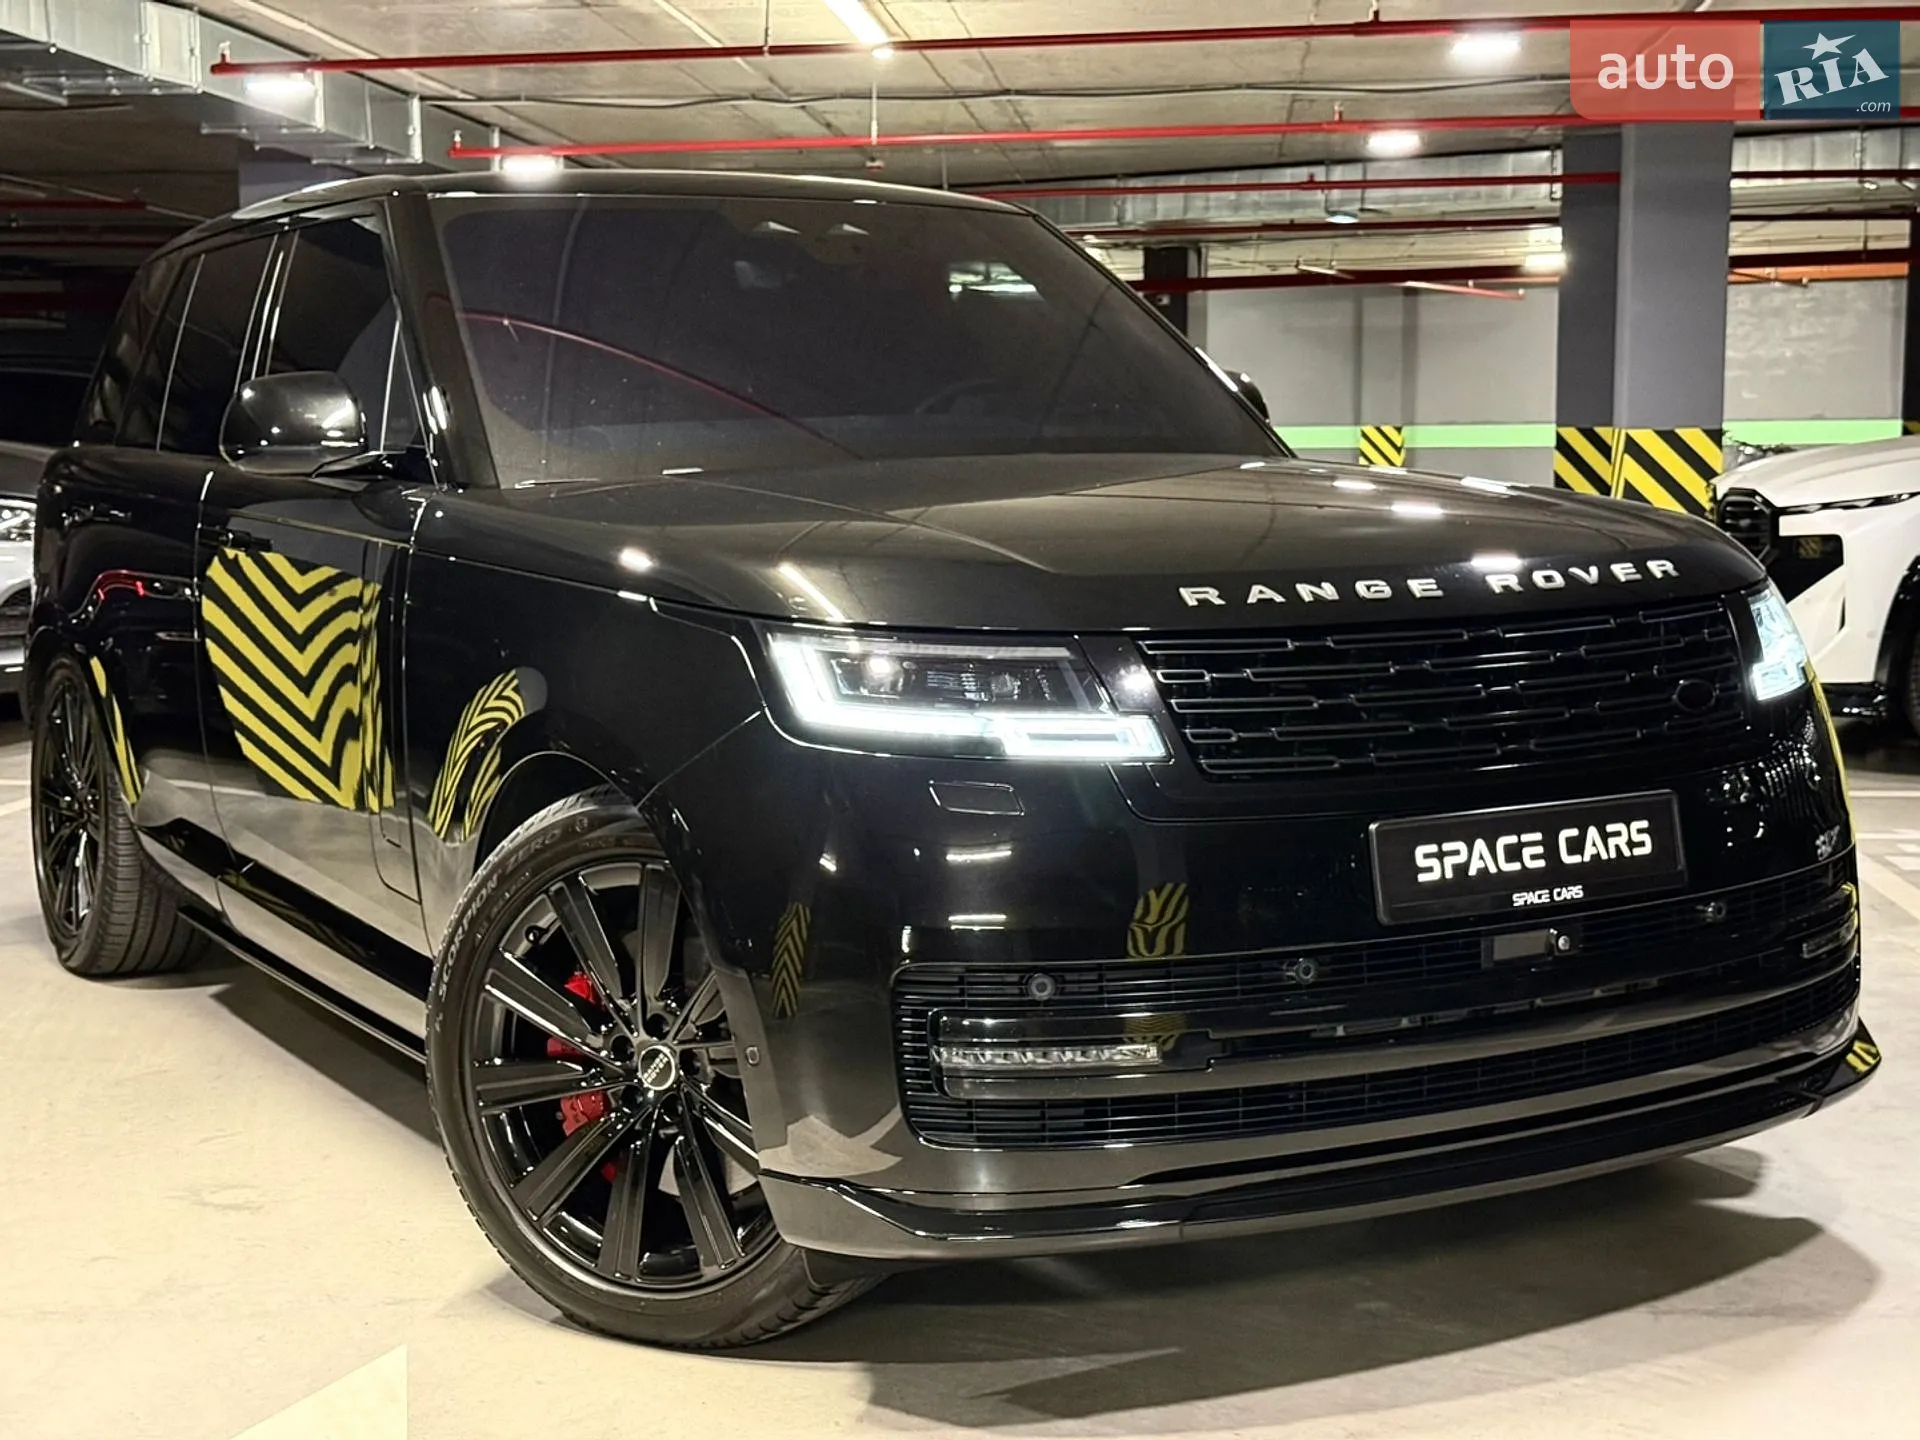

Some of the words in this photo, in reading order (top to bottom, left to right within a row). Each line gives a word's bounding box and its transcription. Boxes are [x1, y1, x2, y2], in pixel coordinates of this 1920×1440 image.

[1178, 577, 1444, 607] RANGE
[1484, 558, 1681, 594] ROVER
[1414, 832, 1546, 883] SPACE
[1558, 820, 1652, 865] CARS
[1512, 889, 1550, 907] SPACE
[1553, 885, 1584, 901] CARS
[438, 872, 499, 1003] SCORPION
